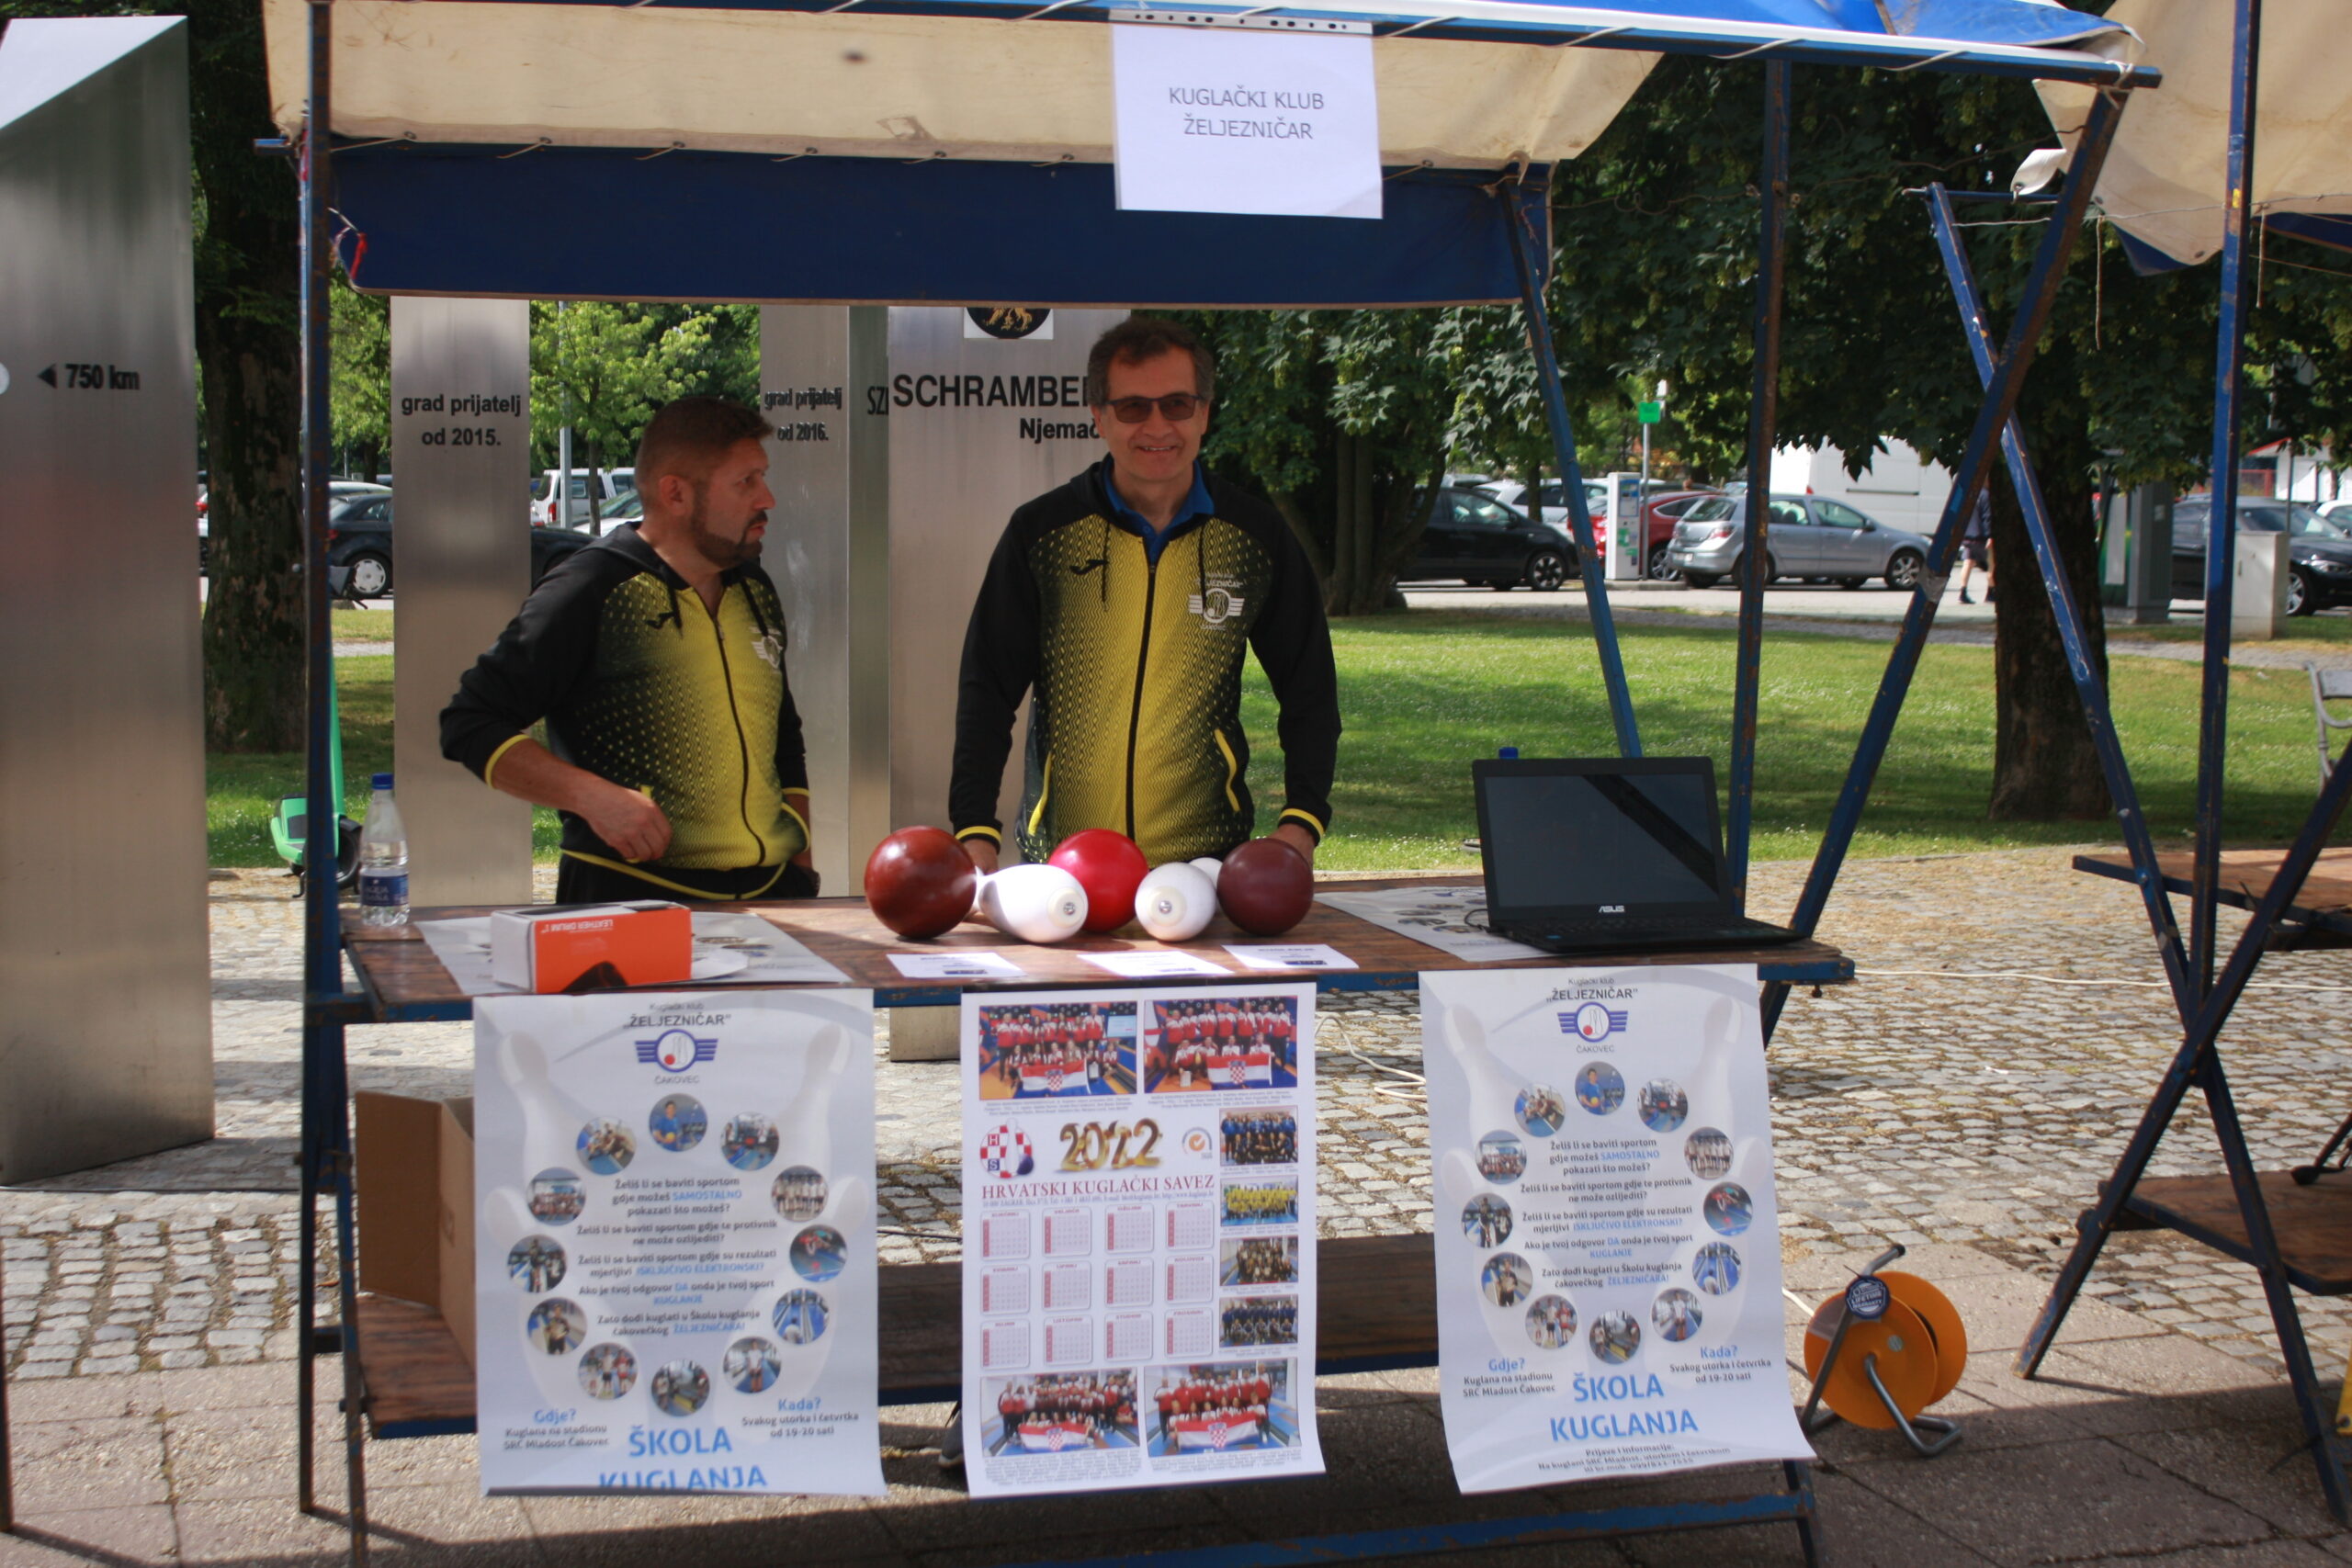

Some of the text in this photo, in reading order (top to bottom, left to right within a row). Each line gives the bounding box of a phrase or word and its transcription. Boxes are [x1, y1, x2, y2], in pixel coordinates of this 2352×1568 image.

[1169, 85, 1324, 109] KUGLAČKI KLUB
[1183, 113, 1313, 140] ŽELJEZNIČAR
[65, 363, 141, 390] 750 km
[401, 393, 521, 417] grad prijatelj
[764, 387, 842, 410] grad prijatelj
[422, 427, 501, 446] od 2015.
[777, 423, 829, 441] od 2016.
[1599, 905, 1624, 913] ASUS
[1576, 1044, 1614, 1054] ČAKOVEC
[1551, 1138, 1571, 1150] Želiš
[1574, 1139, 1580, 1149] li
[1592, 1137, 1618, 1148] baviti
[1620, 1137, 1657, 1148] sportom
[1549, 1150, 1660, 1164] gdje možeš SAMOSTALNO
[1564, 1163, 1650, 1176] pokazati što možeš?
[665, 1179, 695, 1188] baviti
[696, 1177, 740, 1189] sportom
[982, 1174, 1215, 1199] HRVATSKI KUGLAČKI SAVEZ
[1521, 1183, 1541, 1192] Želiš
[1562, 1181, 1586, 1191] baviti
[1588, 1180, 1622, 1191] sportom
[1624, 1179, 1642, 1190] gdje
[1644, 1179, 1652, 1188] te
[1655, 1178, 1692, 1188] protivnik
[612, 1194, 635, 1205] gdje
[638, 1191, 670, 1201] možeš
[1581, 1192, 1603, 1201] može
[1606, 1191, 1647, 1202] ozlijediti?
[628, 1202, 730, 1218] pokazati što možeš?
[1522, 1213, 1542, 1222] Želiš
[1564, 1210, 1588, 1220] baviti
[1589, 1210, 1624, 1221] sportom
[1626, 1208, 1645, 1219] gdje
[1657, 1205, 1692, 1215] rezultati
[655, 1223, 695, 1234] sportom
[1533, 1223, 1569, 1234] mjerljivi
[1623, 1218, 1682, 1229] ELEKTRONSKI?
[1524, 1234, 1693, 1250] Ako je tvoj odgovor onda je tvoj sport
[656, 1253, 697, 1264] sportom
[736, 1249, 776, 1258] rezultati
[1542, 1269, 1560, 1277] Zato
[1583, 1266, 1612, 1276] kuglati
[1622, 1263, 1645, 1273] Školu
[1646, 1262, 1682, 1273] kuglanja
[579, 1286, 597, 1295] Ako
[633, 1284, 673, 1295] odgovor
[750, 1279, 775, 1289] sport
[1700, 1344, 1737, 1359] Kada?
[1488, 1358, 1525, 1372] Gdje?
[1669, 1359, 1771, 1373] Svakog utorka četvrtka
[1464, 1372, 1553, 1386] Kuglana na stadionu
[1695, 1371, 1751, 1383] od 19-20 sati
[1482, 1385, 1517, 1396] Mladost
[1520, 1383, 1555, 1393] Čakovec
[1573, 1371, 1664, 1402] ŠKOLA
[778, 1396, 821, 1411] Kada?
[534, 1408, 577, 1424] Gdje?
[742, 1412, 859, 1427] Svakog utorka četvrtka
[771, 1427, 834, 1438] od 19-20 sati
[1550, 1409, 1699, 1441] KUGLANJA
[629, 1425, 732, 1457] ŠKOLA
